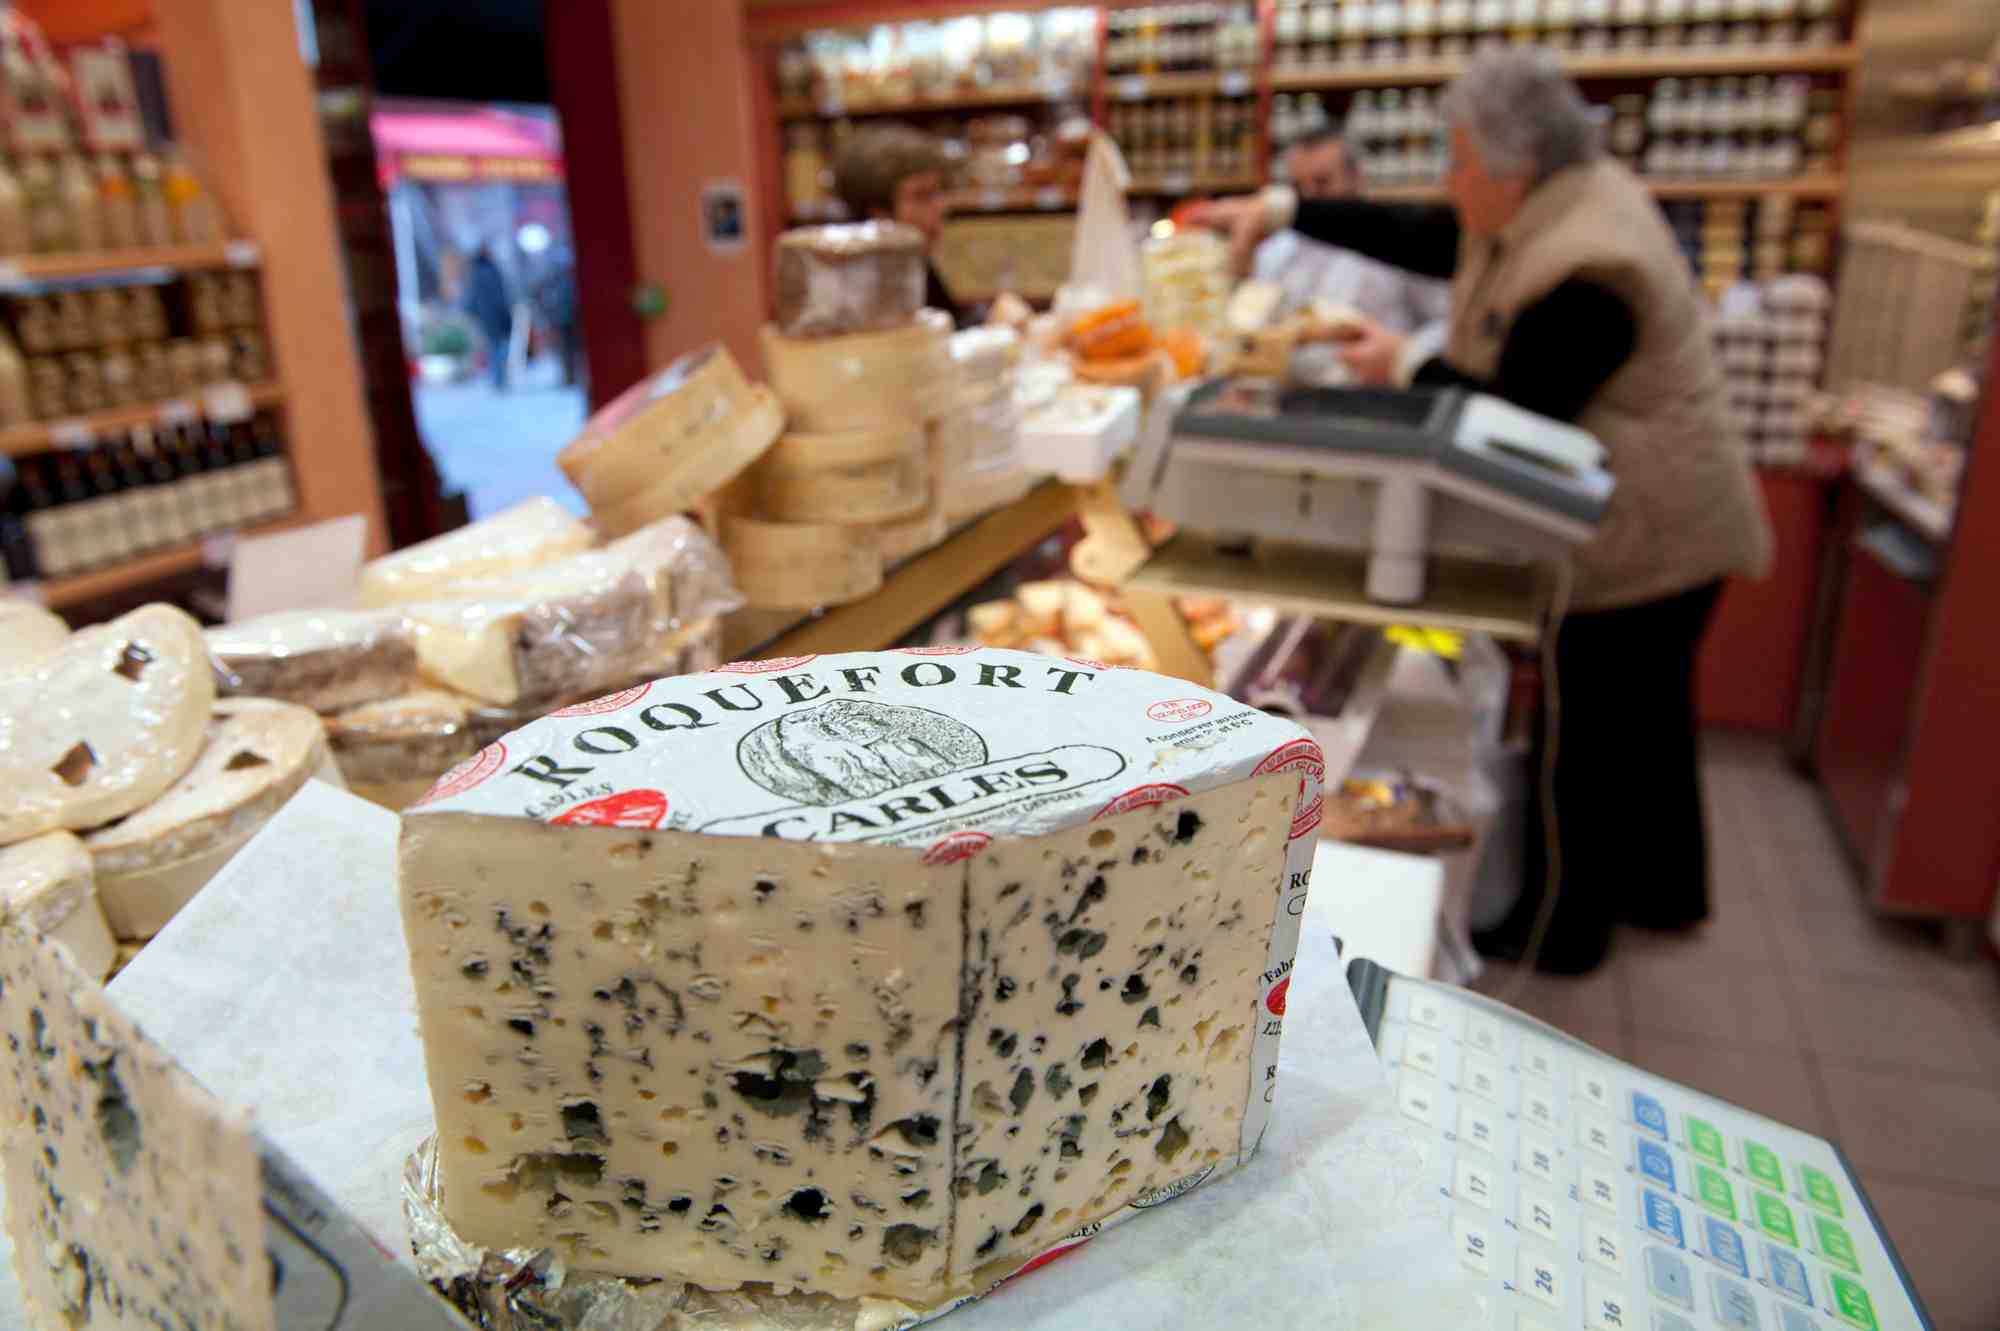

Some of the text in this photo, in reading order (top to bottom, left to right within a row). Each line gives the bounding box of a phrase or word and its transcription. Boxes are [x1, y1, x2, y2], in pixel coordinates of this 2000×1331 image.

[506, 661, 1095, 790] ROQUEFORT
[761, 760, 1068, 842] CARLES
[1470, 1175, 1488, 1197] 17
[1533, 1204, 1552, 1230] 27
[1467, 1233, 1486, 1258] 16
[1598, 1235, 1617, 1261] 37
[1535, 1266, 1553, 1295] 26
[1603, 1300, 1623, 1329] 36
